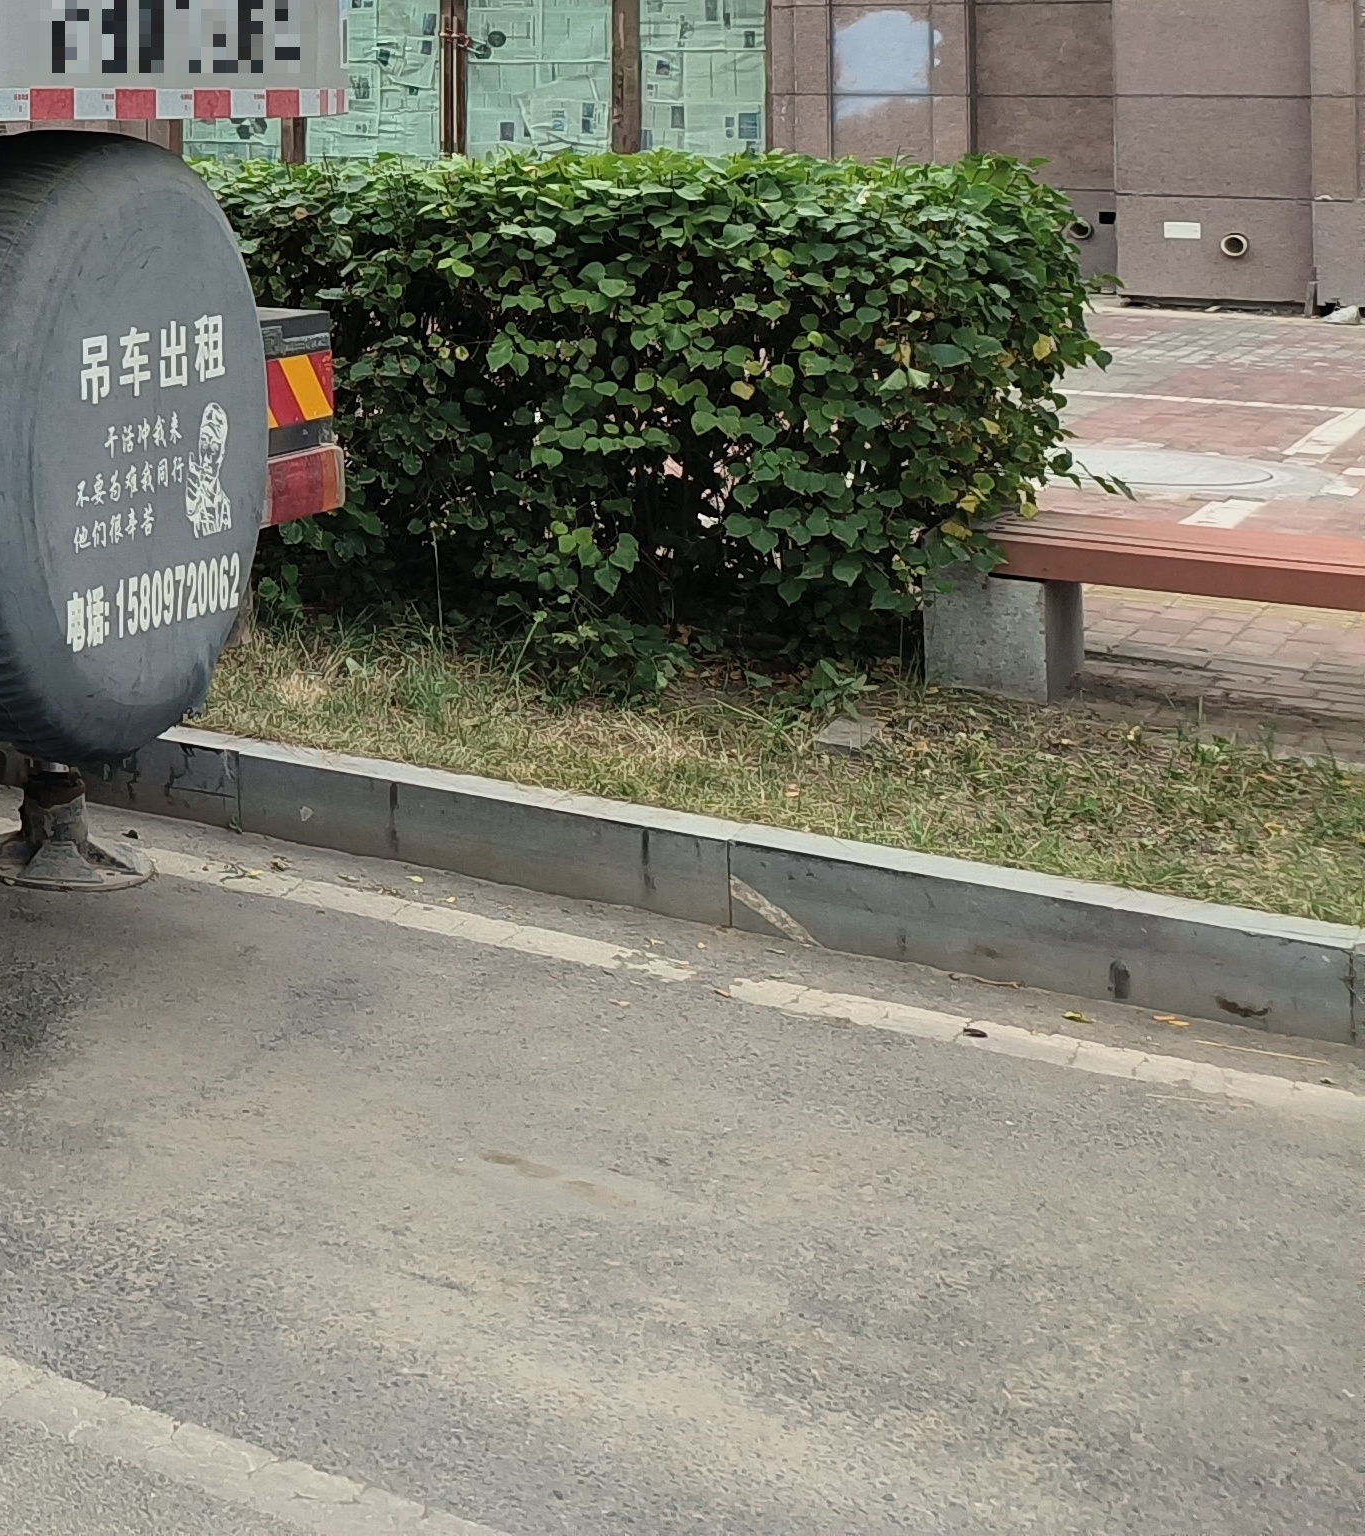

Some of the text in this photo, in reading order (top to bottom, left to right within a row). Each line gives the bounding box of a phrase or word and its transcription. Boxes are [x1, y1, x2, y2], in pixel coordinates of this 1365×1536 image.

[80, 314, 226, 405] 吊车出租
[104, 410, 183, 459] 干活冲我来
[75, 455, 185, 508] 不要为难我同行
[73, 502, 155, 554] 他们很辛苦
